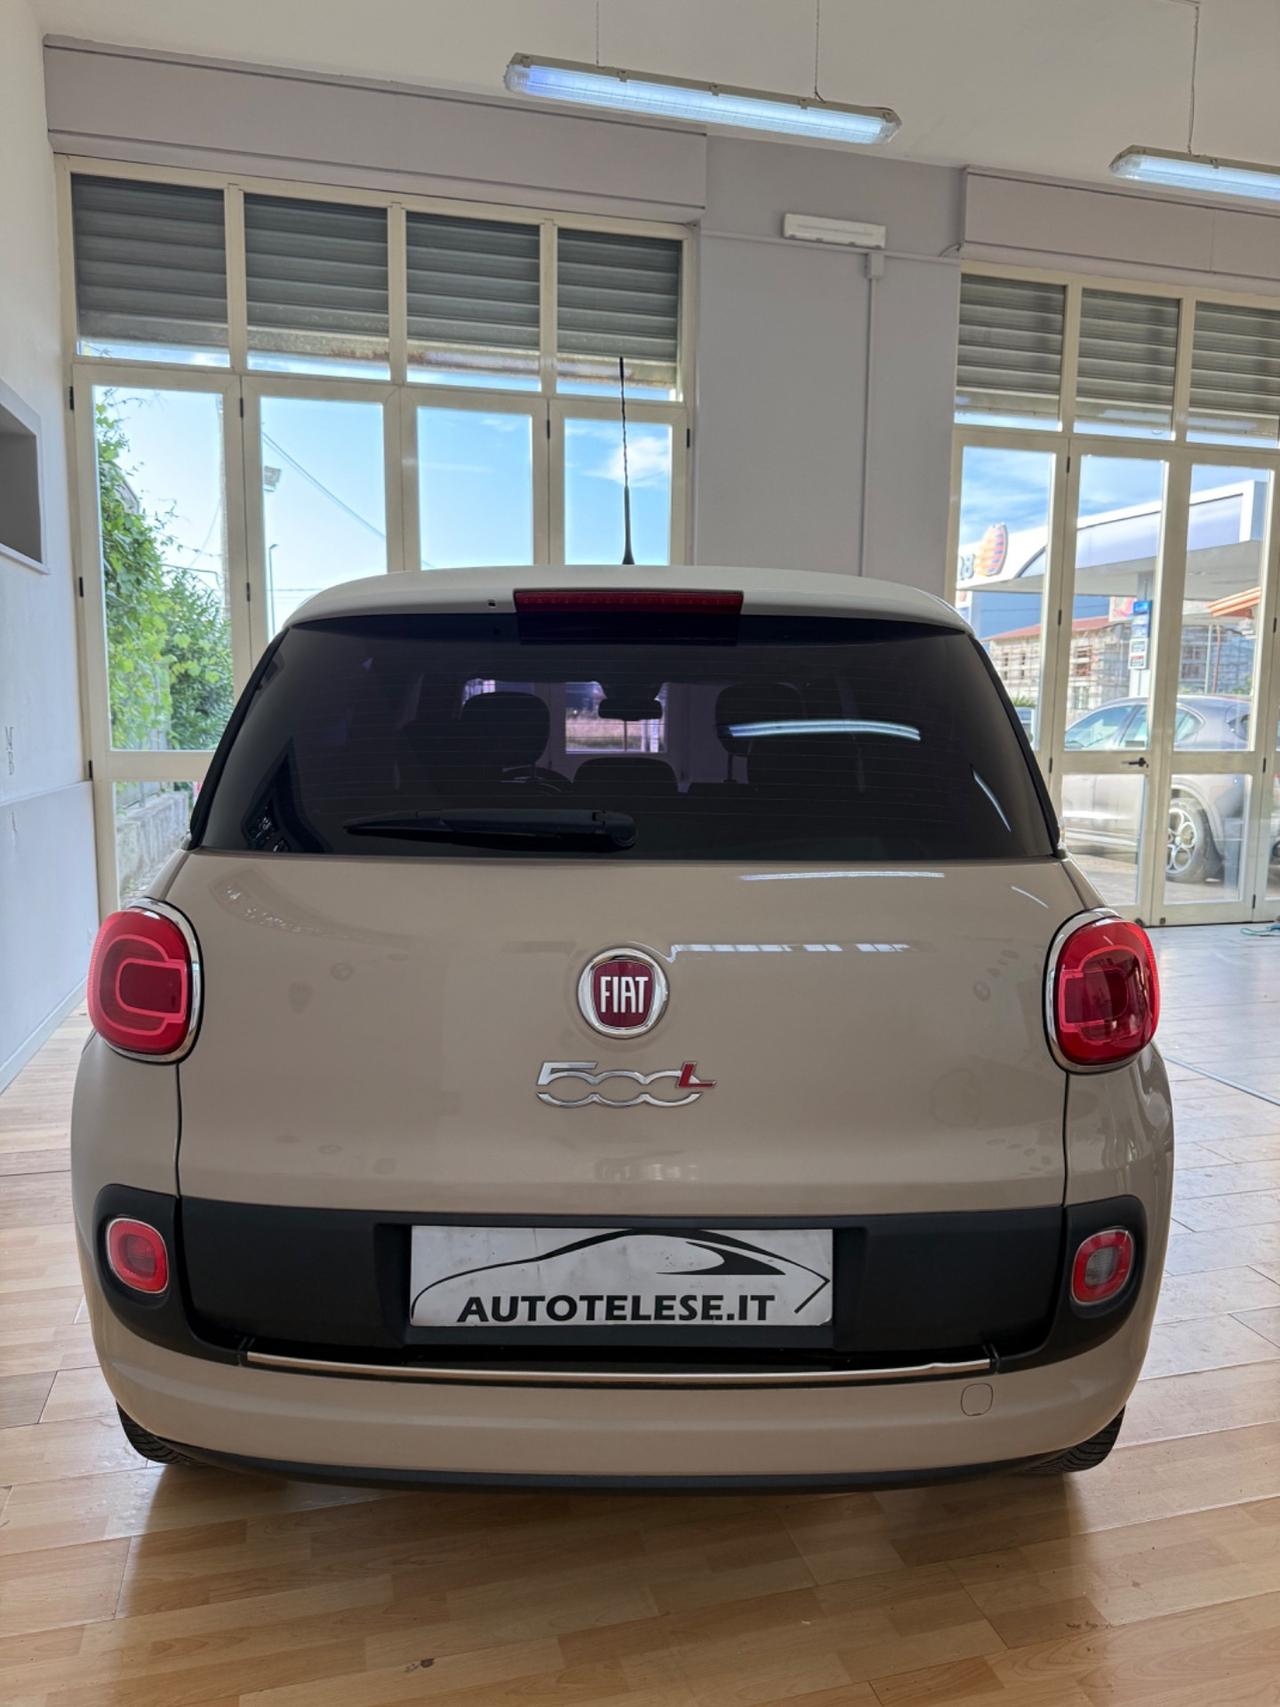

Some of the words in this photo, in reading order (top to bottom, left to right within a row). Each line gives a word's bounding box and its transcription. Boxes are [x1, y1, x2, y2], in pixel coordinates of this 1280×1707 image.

[600, 976, 649, 1013] FIAT
[537, 1061, 717, 1108] 500L
[457, 1295, 775, 1323] AUTOTELESE.IT
